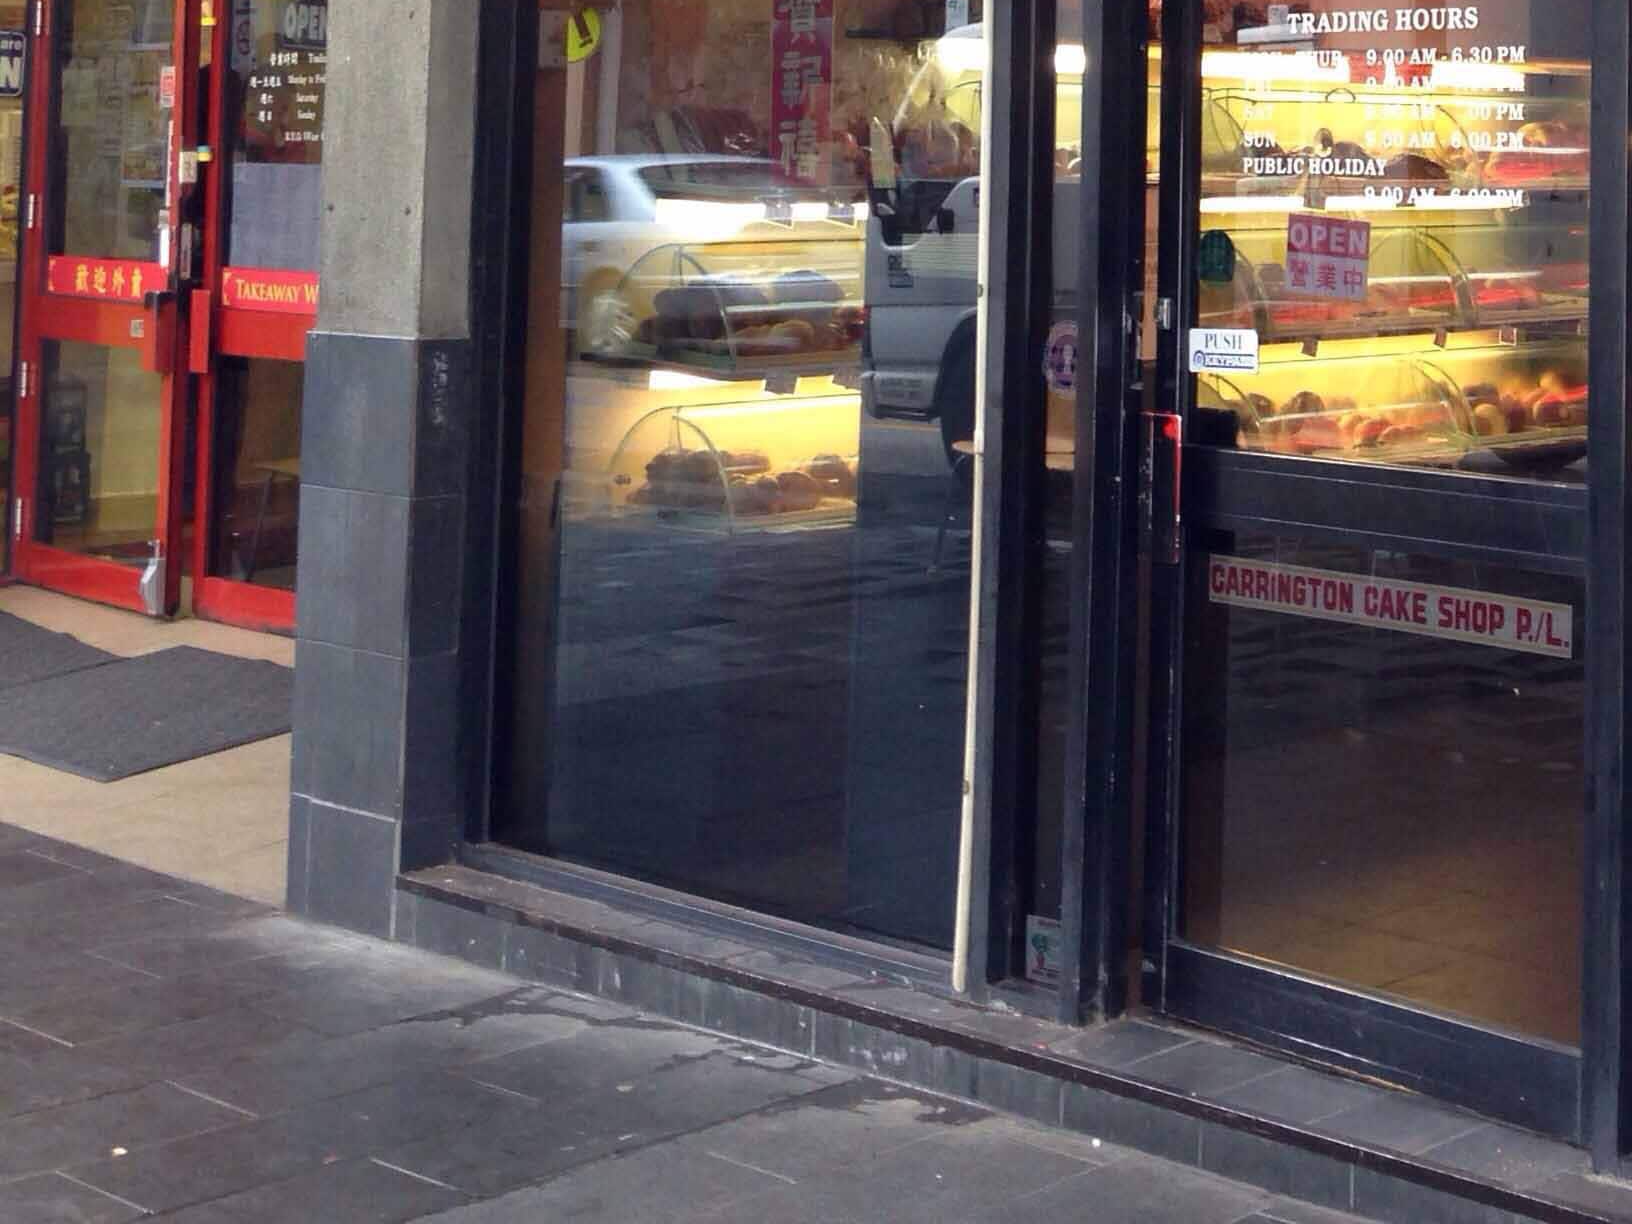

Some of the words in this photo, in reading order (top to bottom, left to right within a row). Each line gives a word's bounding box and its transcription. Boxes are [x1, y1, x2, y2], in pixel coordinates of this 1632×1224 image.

[1287, 10, 1389, 34] TRADING
[1396, 6, 1479, 31] HOURS
[1410, 47, 1437, 65] AM
[1451, 46, 1492, 65] 6.30
[1496, 46, 1526, 64] PM
[1496, 103, 1525, 121] PM
[1243, 132, 1276, 149] SUN
[1496, 131, 1525, 149] PM
[1243, 157, 1304, 175] PUBLIC
[1308, 157, 1387, 177] HOLIDAY
[1289, 222, 1368, 255] OPEN
[234, 278, 299, 303] TAKEAWAY
[1204, 333, 1243, 351] PUSH
[1210, 563, 1354, 614] CARRINGTON
[1363, 586, 1428, 626] CAKE
[1437, 595, 1506, 636] SHOP
